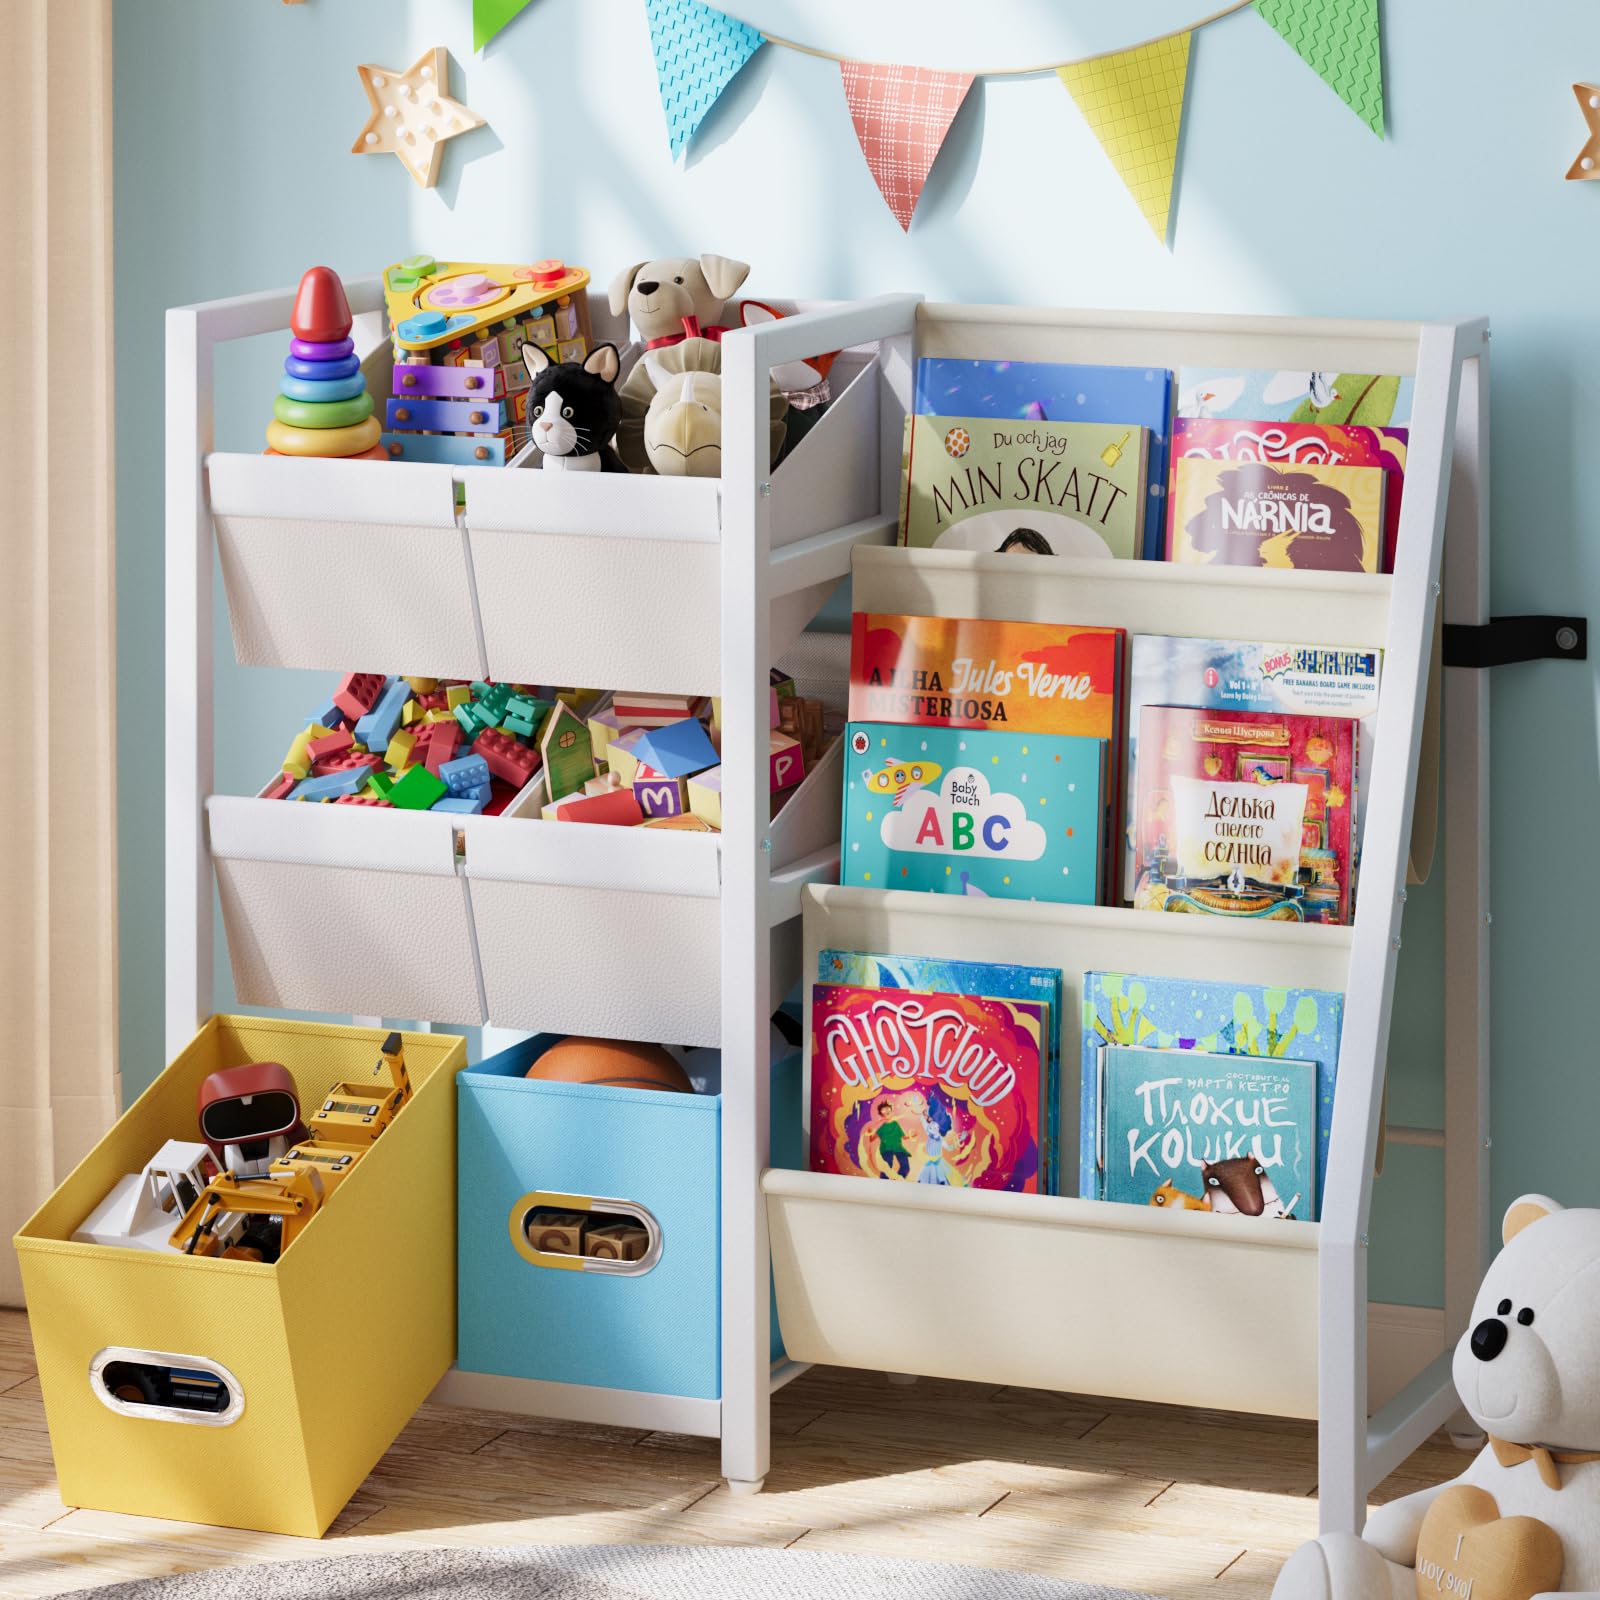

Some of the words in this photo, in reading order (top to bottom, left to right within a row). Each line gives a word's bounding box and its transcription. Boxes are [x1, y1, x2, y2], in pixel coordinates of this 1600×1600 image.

[994, 432, 1013, 449] Du
[1016, 429, 1041, 445] och
[1037, 433, 1068, 455] jag
[932, 462, 1002, 525] MIN
[1013, 457, 1128, 526] SKATT
[1258, 490, 1297, 501] CRÔNICAS
[1299, 493, 1310, 501] DE
[1264, 652, 1292, 673] BONUS
[868, 666, 883, 687] A
[948, 657, 1014, 697] Jules
[1017, 661, 1092, 700] Verne
[1282, 678, 1294, 686] FREE
[1295, 679, 1318, 688] BANANAS
[1337, 682, 1351, 690] GAME
[1351, 683, 1376, 691] INCLUDED
[868, 691, 1008, 722] MISTERIOSA
[1203, 724, 1232, 735] Ксения
[1233, 726, 1275, 738] Шустрова
[775, 755, 793, 786] P
[641, 786, 674, 815] M
[950, 793, 980, 807] Touch
[952, 781, 977, 797] Baby
[1204, 790, 1275, 821] Долька
[1215, 821, 1264, 839] спелого
[1204, 840, 1272, 868] солнца
[823, 999, 1017, 1107] GHOSTCLOUD
[1187, 1077, 1233, 1090] МАРТА
[1239, 1081, 1290, 1094] КЕТРО
